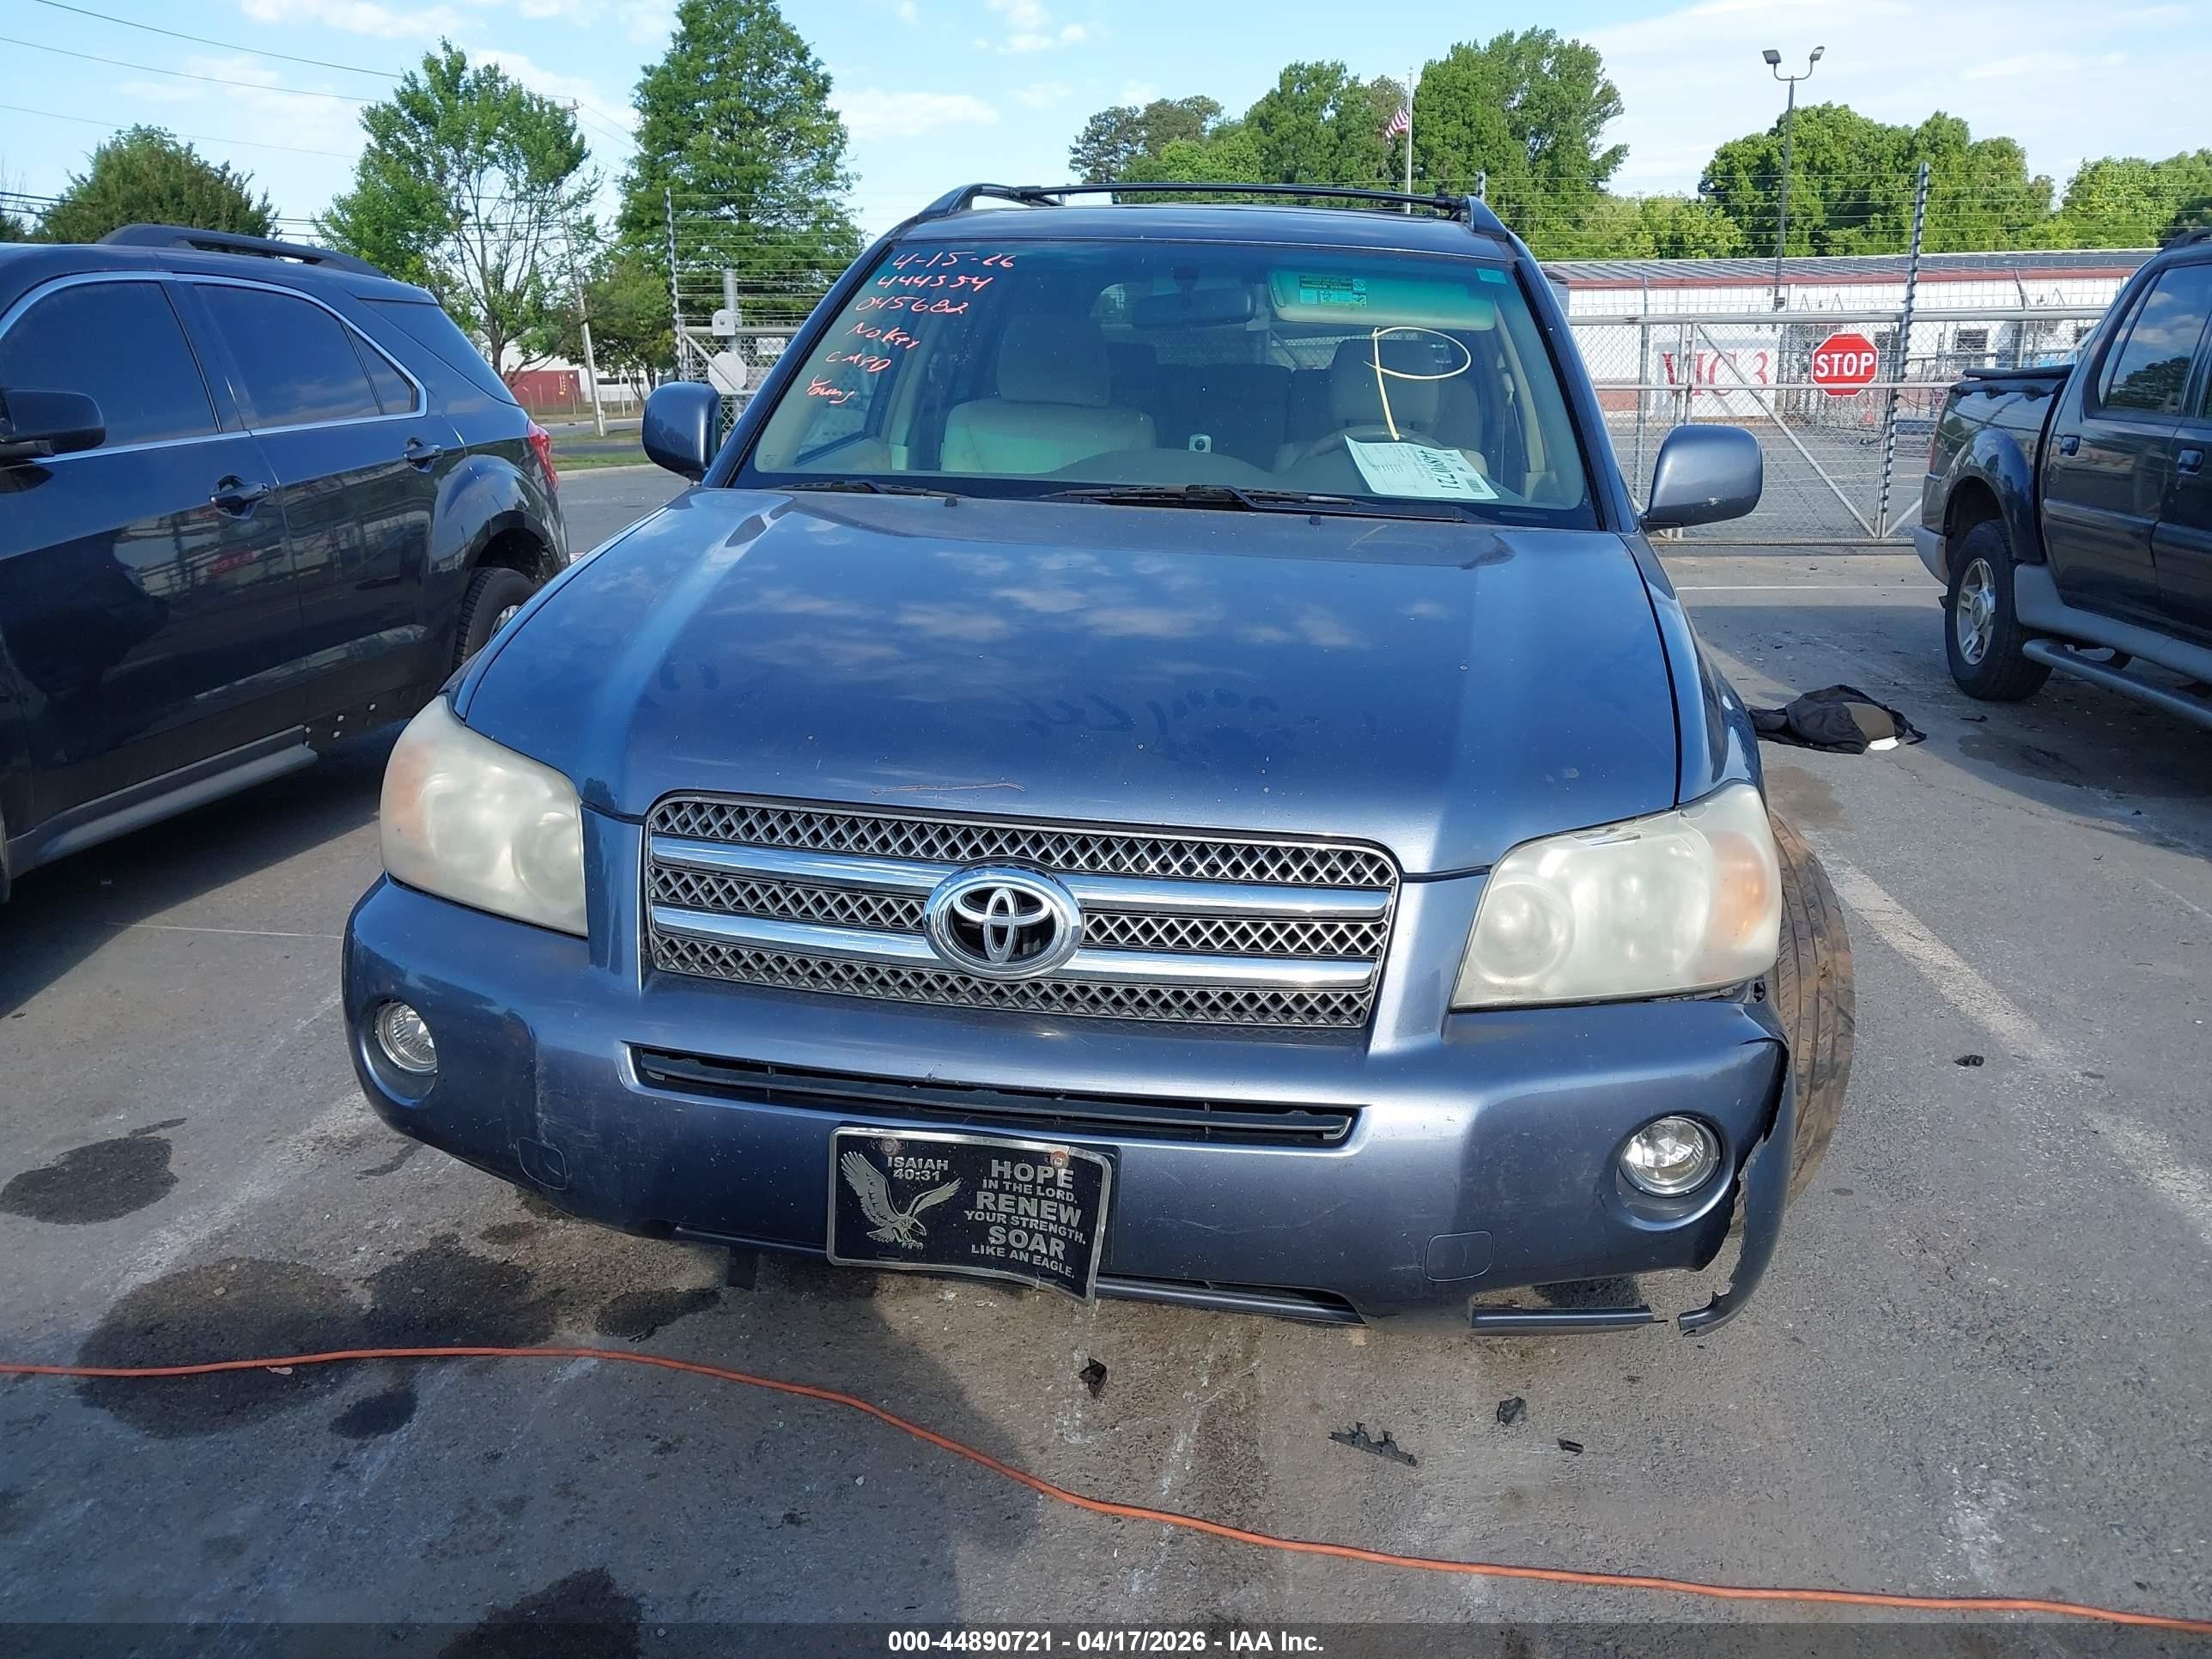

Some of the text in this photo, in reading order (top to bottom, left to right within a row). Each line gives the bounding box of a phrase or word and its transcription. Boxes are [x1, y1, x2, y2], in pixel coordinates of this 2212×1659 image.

[1815, 352, 1875, 378] STOP
[887, 1156, 949, 1170] ISAIAH
[893, 1169, 940, 1182] 40:31
[990, 1159, 1074, 1189] HOPE
[982, 1179, 1078, 1204] IN THE LORD.
[975, 1191, 1082, 1228] RENEW
[963, 1210, 1086, 1244] YOUR STRENGTH.
[988, 1224, 1066, 1260] SOAR
[970, 1244, 1075, 1279] LIKE AN EAGLE.
